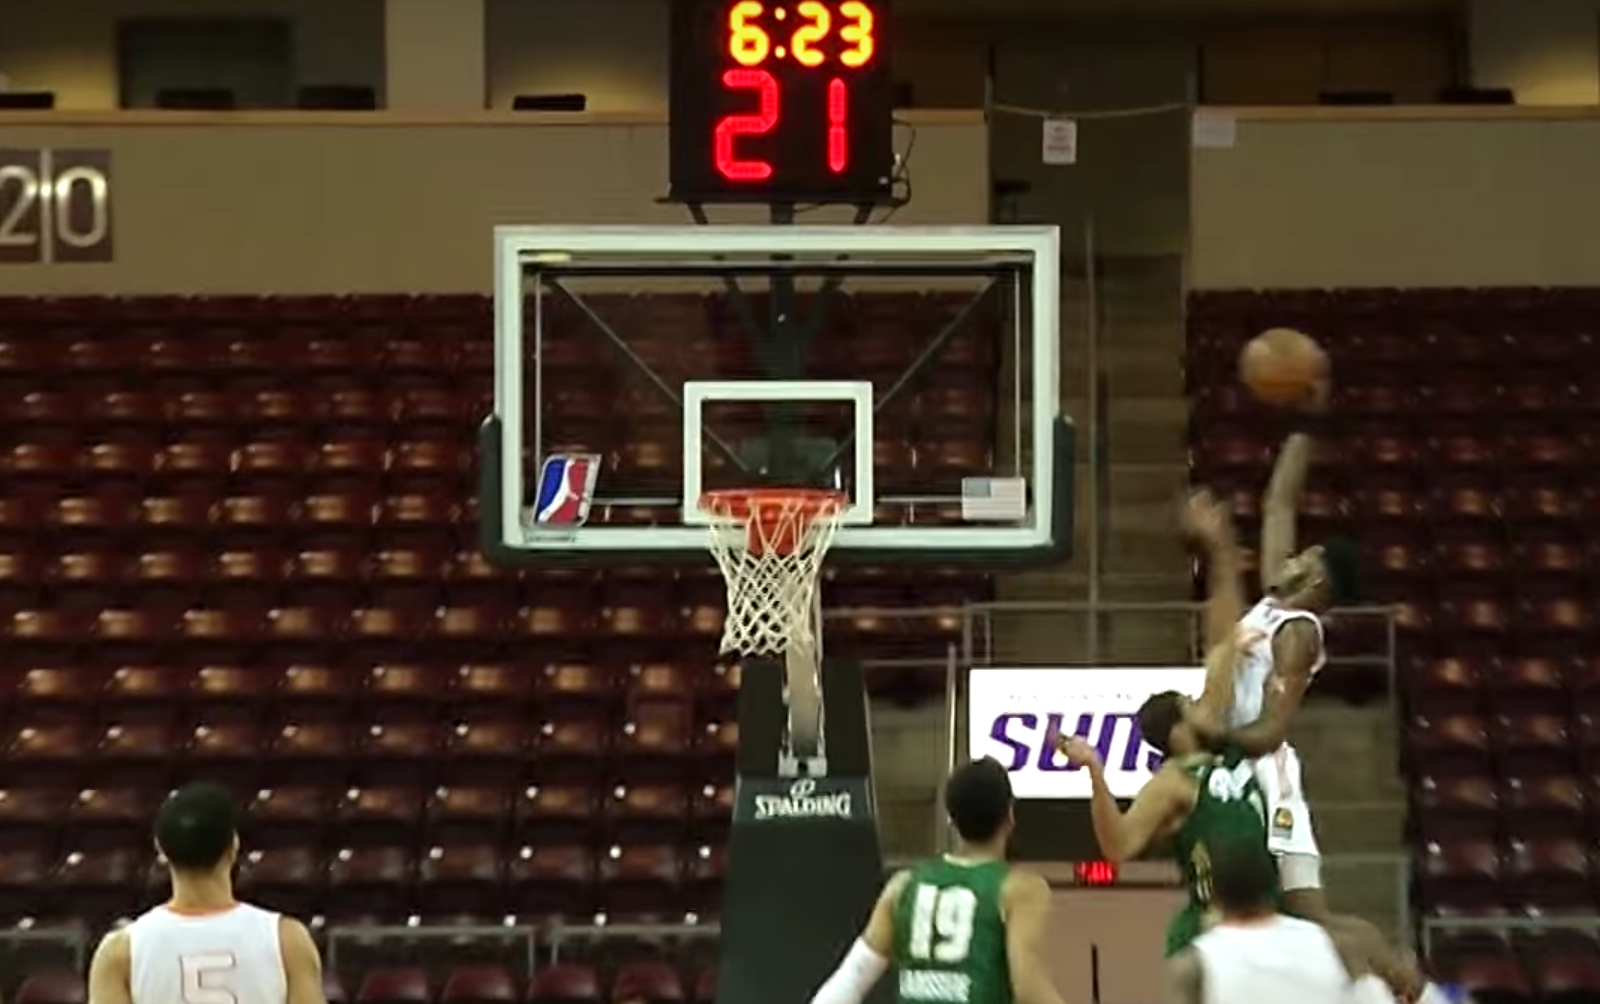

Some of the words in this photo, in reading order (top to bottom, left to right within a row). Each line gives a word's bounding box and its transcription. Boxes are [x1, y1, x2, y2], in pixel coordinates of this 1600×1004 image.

[730, 1, 873, 67] 6:23
[715, 69, 846, 180] 21
[754, 793, 852, 819] SPALDING
[909, 883, 978, 963] 19
[178, 949, 239, 1004] 5
